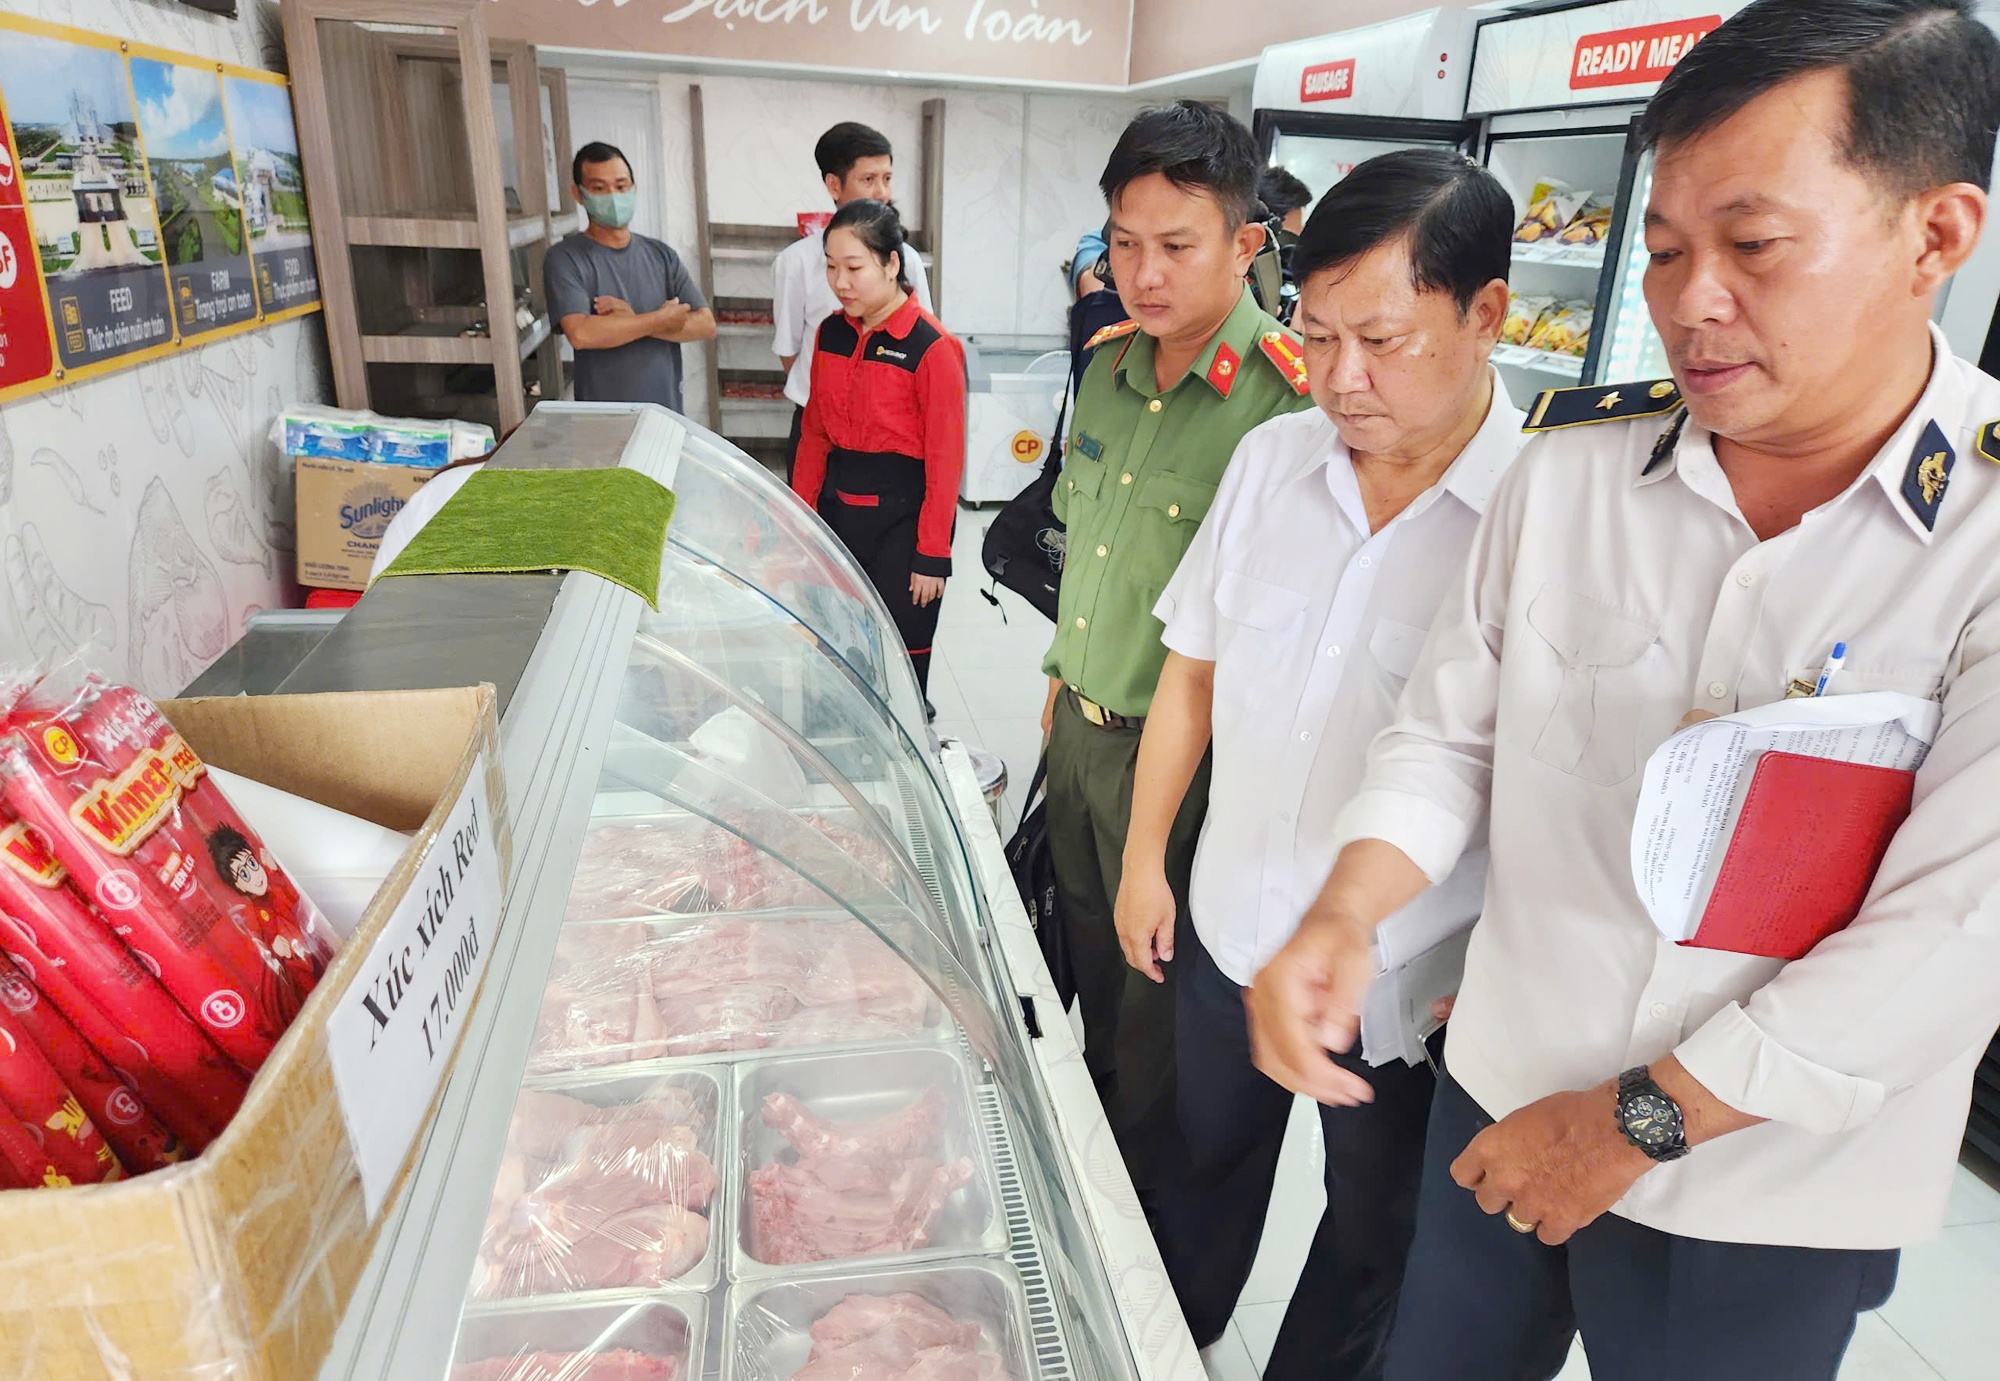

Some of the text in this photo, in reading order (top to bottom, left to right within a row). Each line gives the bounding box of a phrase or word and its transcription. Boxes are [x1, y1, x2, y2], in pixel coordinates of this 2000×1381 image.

[1576, 40, 1646, 77] READY
[1305, 68, 1350, 95] SAUSAGE
[210, 269, 230, 292] FARM
[284, 257, 300, 277] FOOD
[109, 286, 133, 313] FEED
[80, 757, 171, 841] Winner
[361, 797, 481, 1053] Xúc xích Red
[421, 914, 480, 1065] 17.000đ
